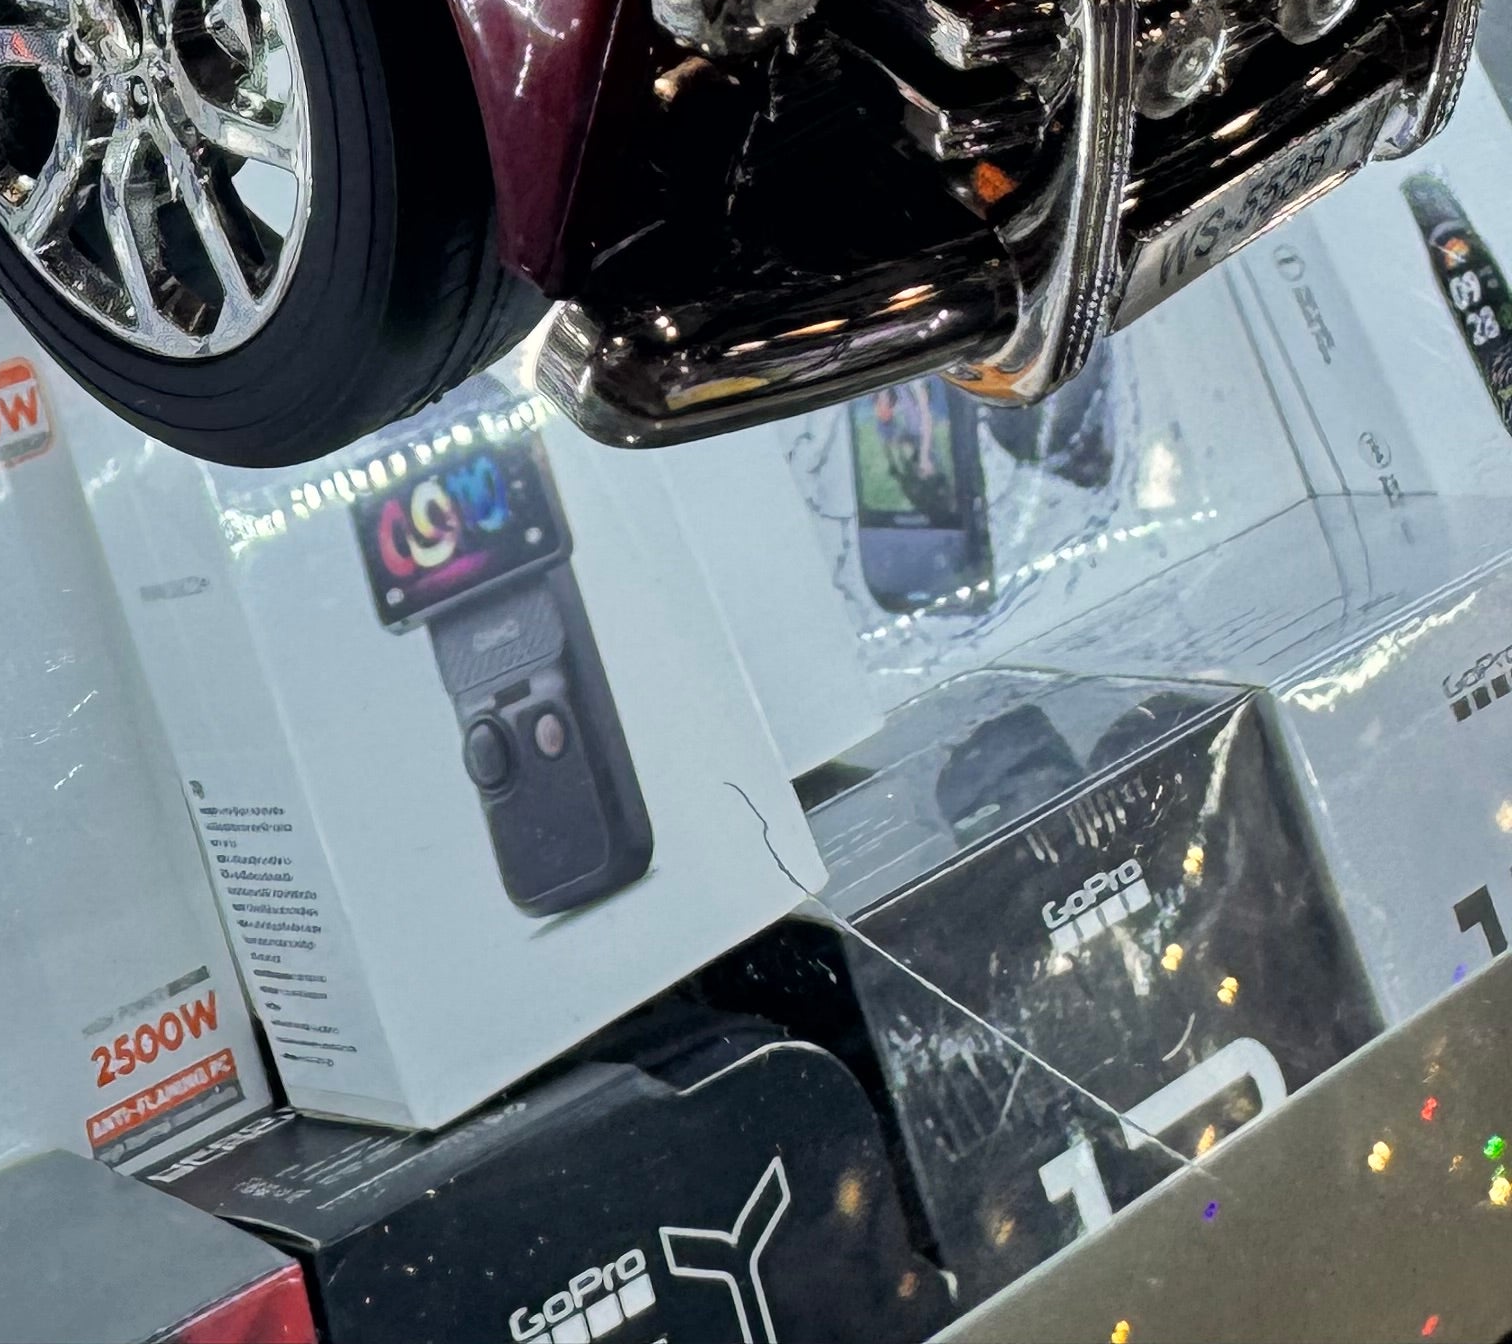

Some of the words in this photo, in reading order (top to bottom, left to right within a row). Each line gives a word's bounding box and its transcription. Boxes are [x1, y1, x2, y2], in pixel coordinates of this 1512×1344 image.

[1042, 858, 1144, 930] GoPro
[91, 990, 218, 1088] 2500W
[509, 1248, 647, 1342] GoPro
